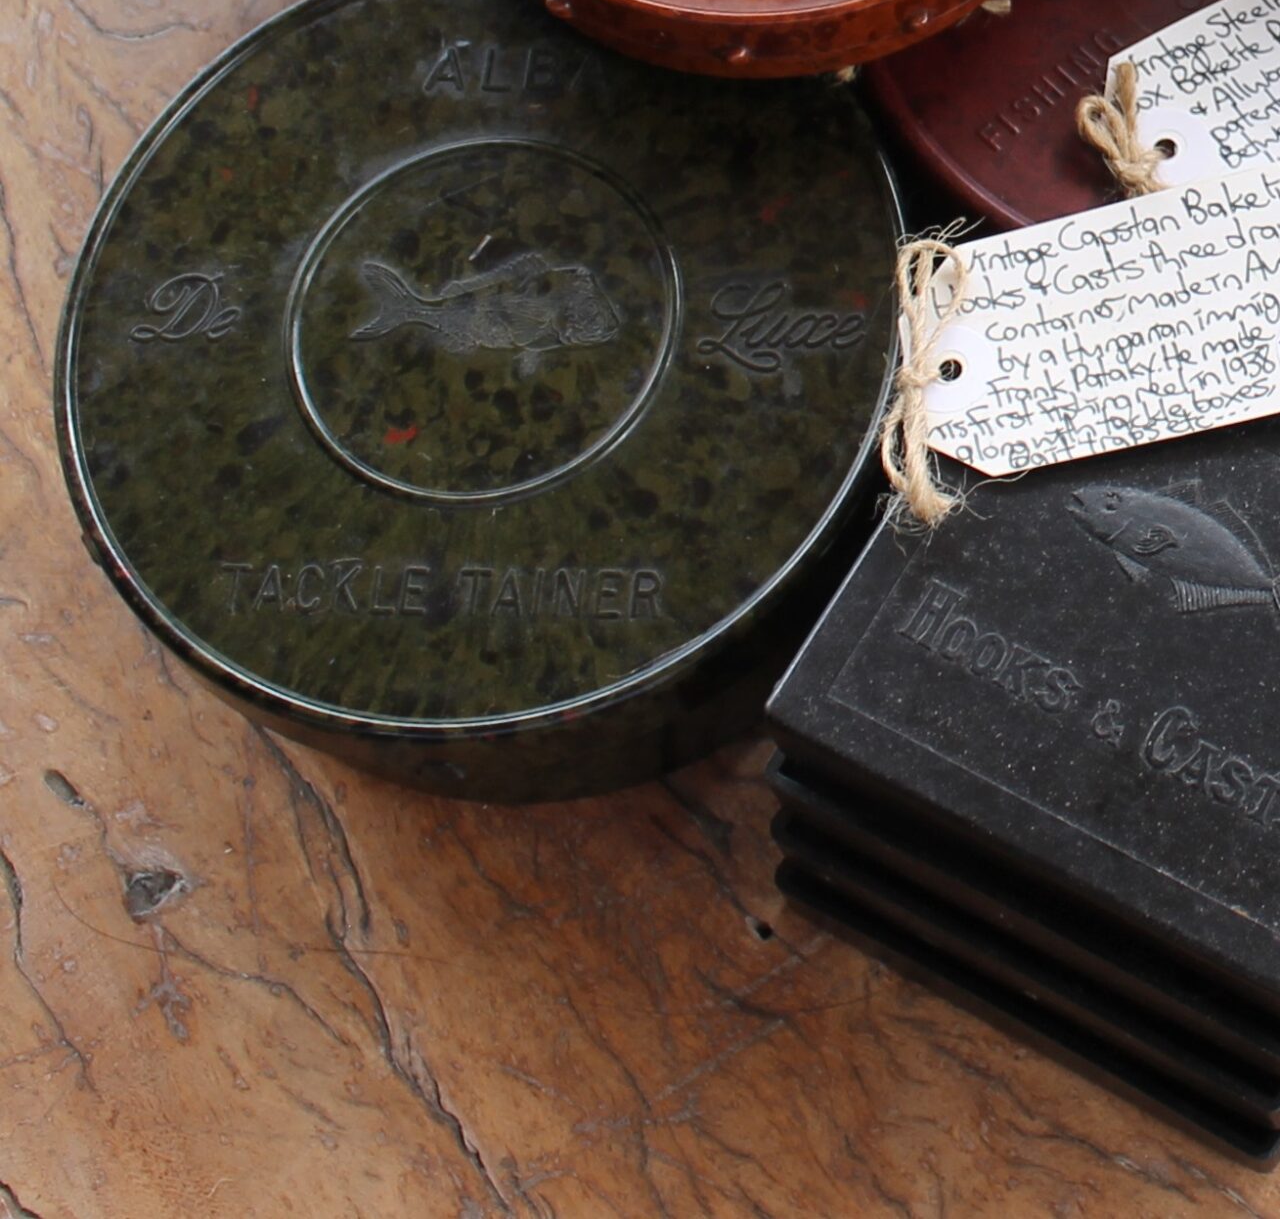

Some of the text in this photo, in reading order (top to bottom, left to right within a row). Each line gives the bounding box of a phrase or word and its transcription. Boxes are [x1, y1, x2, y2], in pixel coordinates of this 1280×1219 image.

[975, 30, 1125, 153] FISHING
[1170, 34, 1274, 95] Bakelite
[1057, 205, 1181, 264] Capstan
[1053, 252, 1145, 295] Casts
[1140, 240, 1228, 274] three
[1128, 270, 1212, 315] made
[1207, 273, 1243, 292] in
[130, 272, 243, 343] De
[695, 281, 869, 372] Luxe
[965, 393, 1034, 441] first
[1036, 377, 1133, 425] fishing
[1135, 366, 1193, 406] reel
[1189, 370, 1221, 394] in
[1221, 343, 1276, 385] 1938
[986, 362, 1068, 408] Frank
[1160, 341, 1198, 371] He
[1201, 313, 1276, 361] made
[997, 346, 1031, 381] by
[1038, 349, 1058, 366] a
[955, 369, 1276, 464] along with tackle boxes,
[1078, 415, 1160, 456] traps
[218, 556, 669, 622] TACKLE TAINER
[1090, 698, 1126, 750] &
